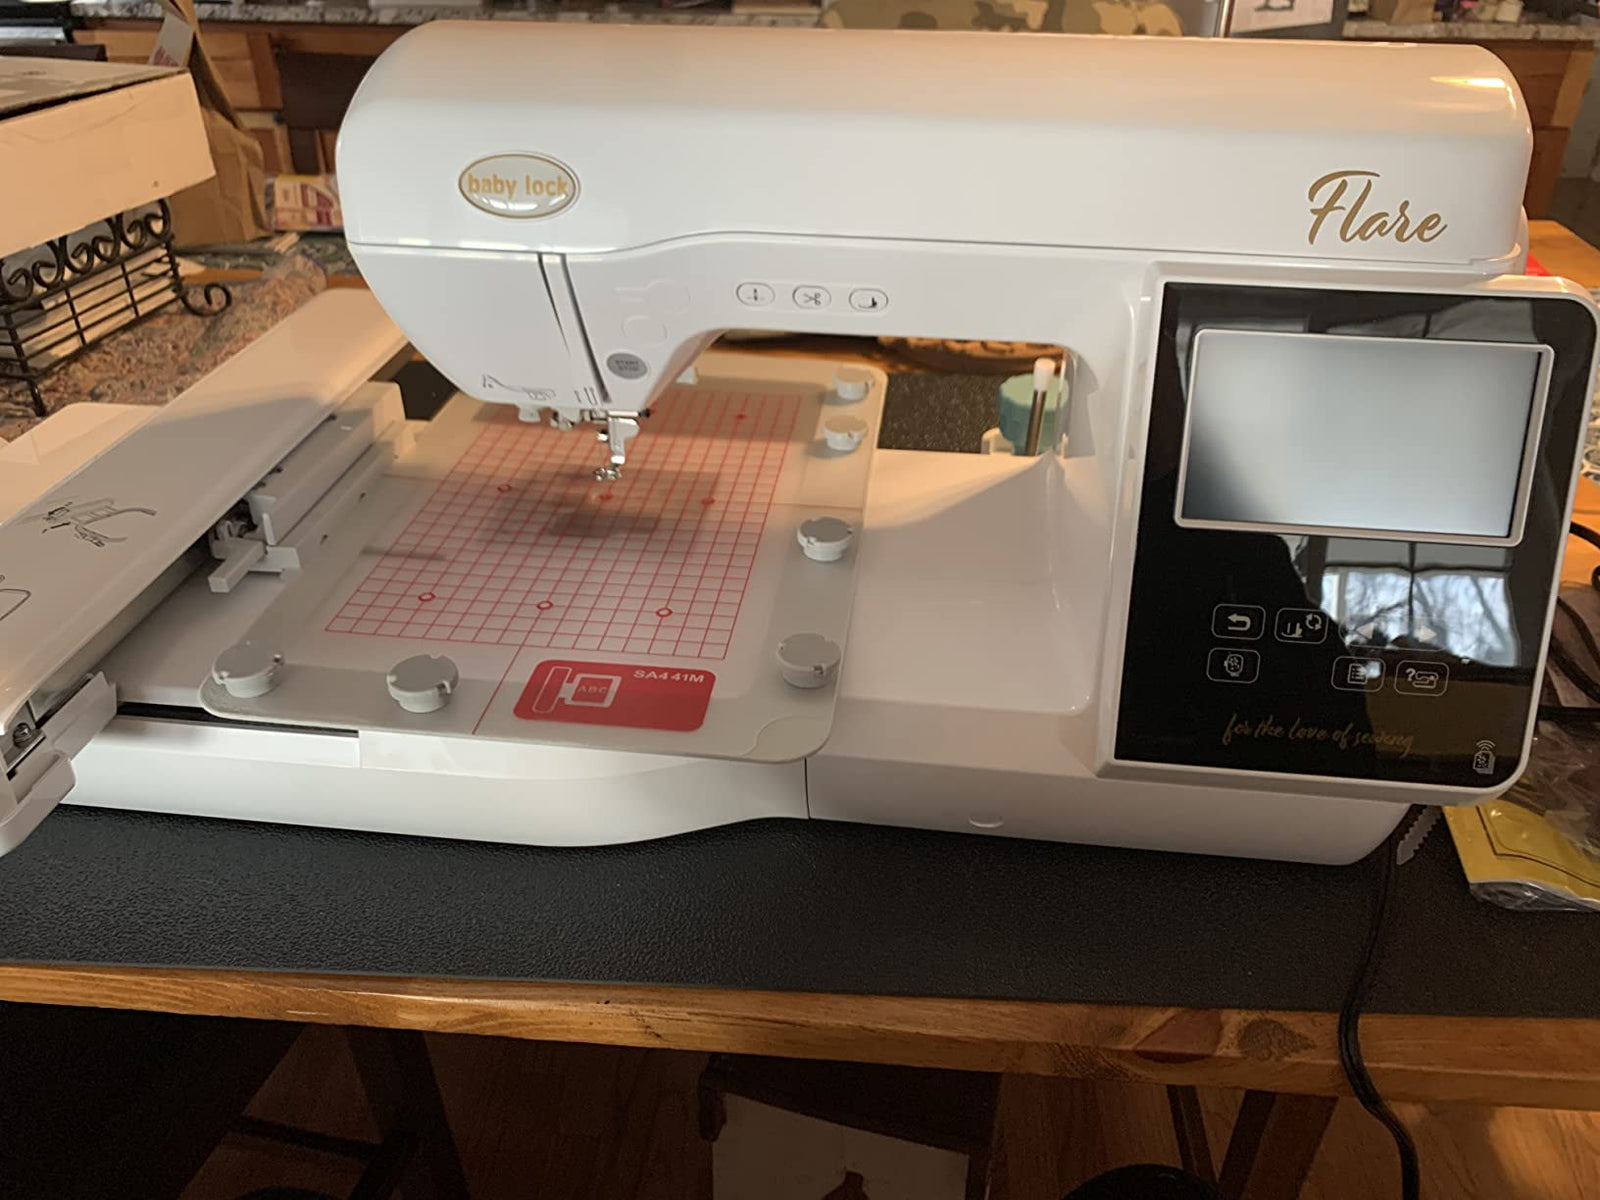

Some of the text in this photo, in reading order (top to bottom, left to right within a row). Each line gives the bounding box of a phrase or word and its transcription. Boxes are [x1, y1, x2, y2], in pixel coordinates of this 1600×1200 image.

[467, 172, 568, 200] baby lock
[1308, 170, 1447, 245] Flare
[633, 669, 705, 683] SA441M
[1222, 713, 1252, 746] for
[1254, 715, 1284, 738] the
[1288, 718, 1328, 740] love
[1332, 722, 1353, 750] of
